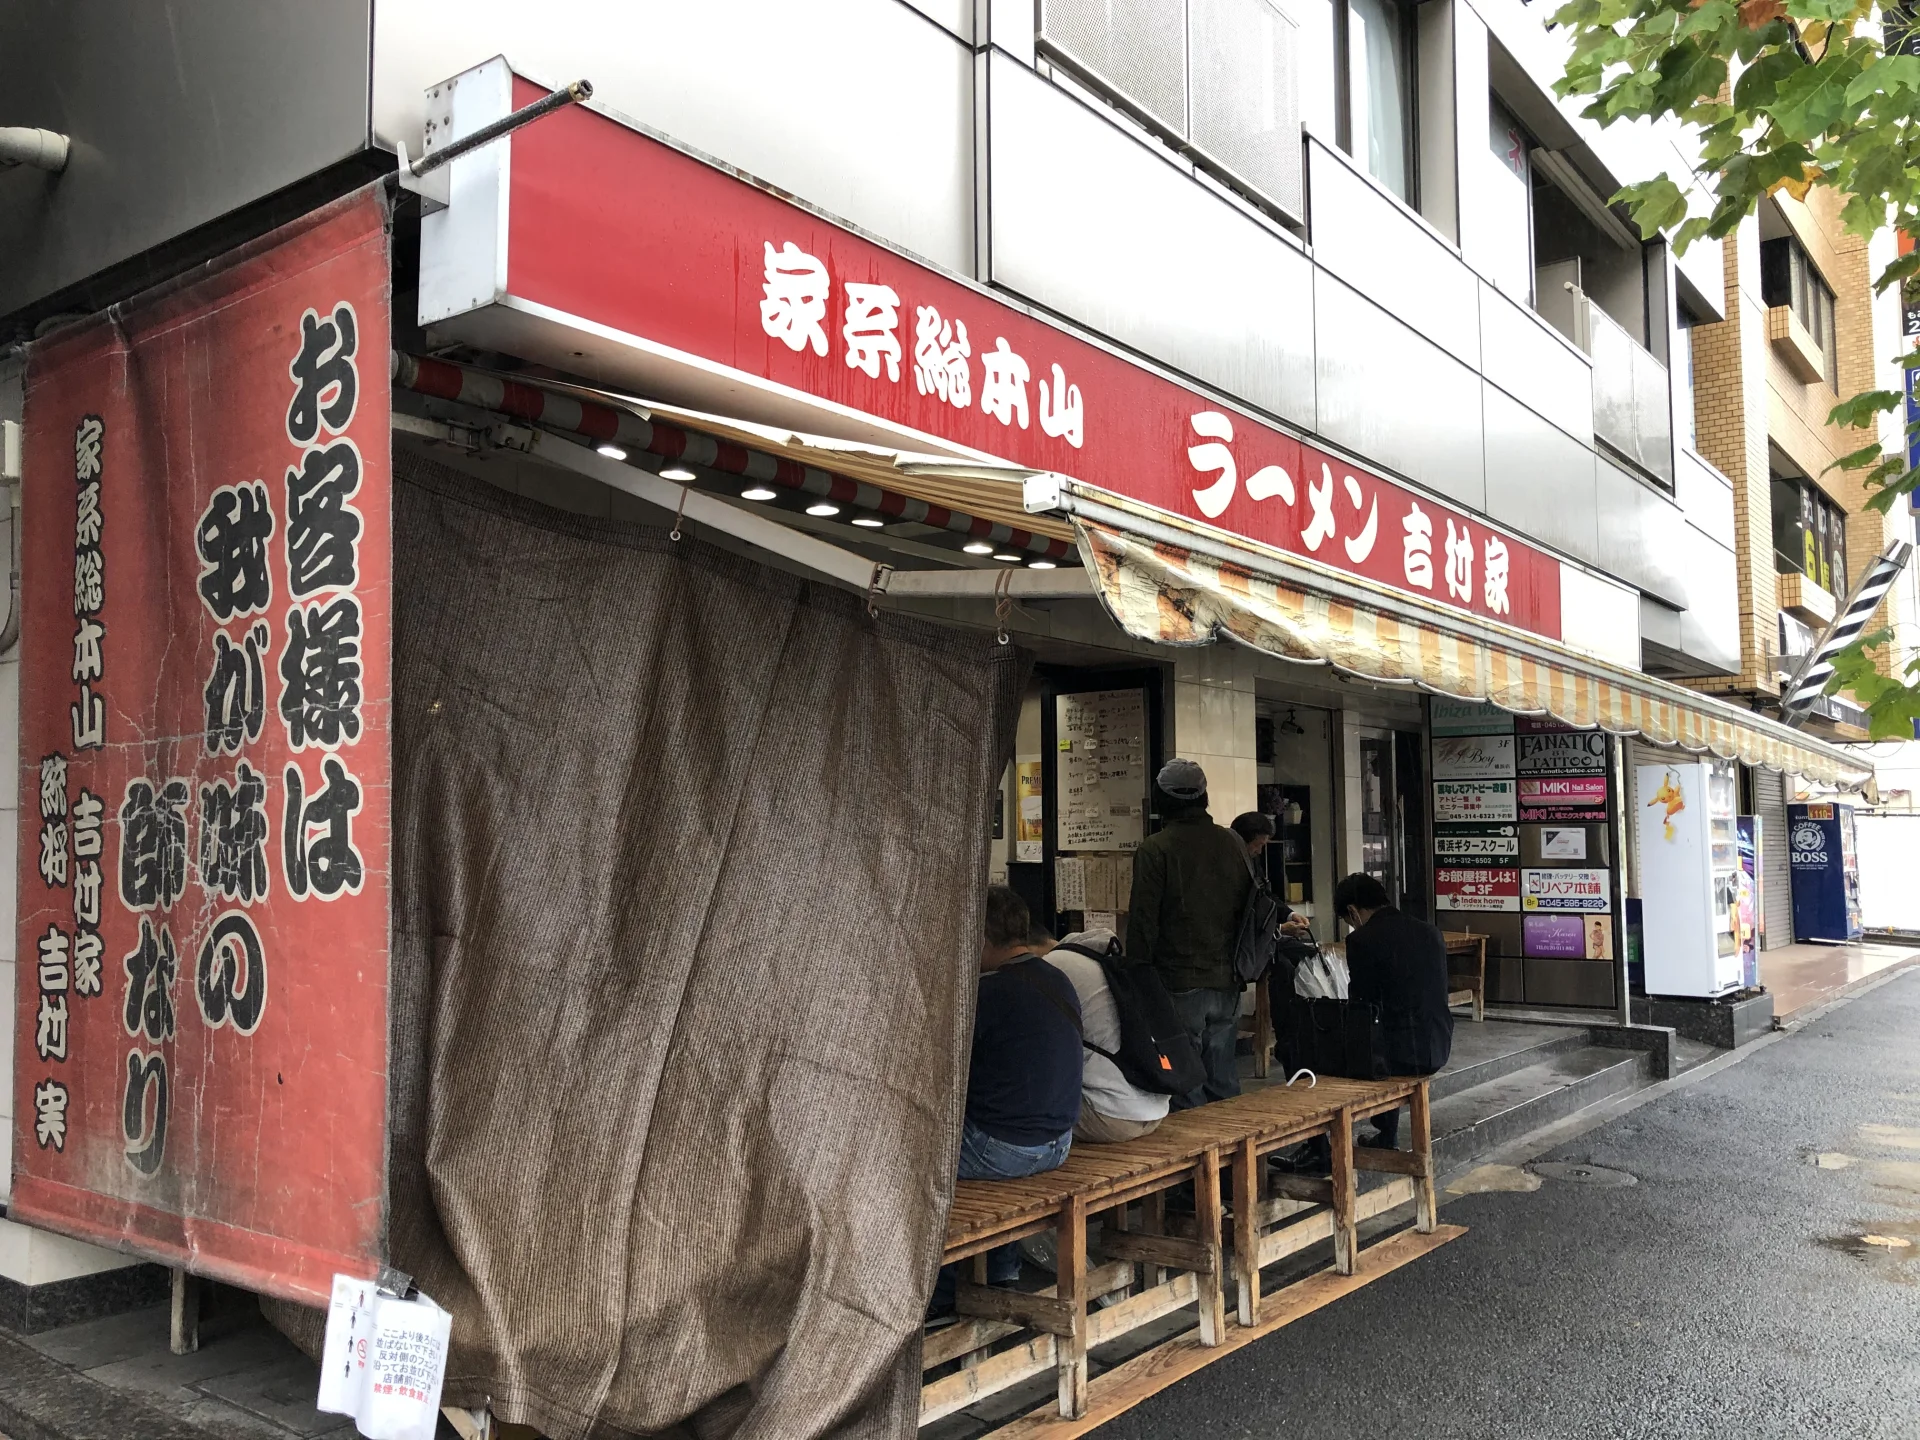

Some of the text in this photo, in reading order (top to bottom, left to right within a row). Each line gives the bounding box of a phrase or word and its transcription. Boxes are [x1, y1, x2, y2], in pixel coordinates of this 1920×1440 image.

[759, 240, 1510, 616] 家系総本山 ラーメン 吉村家
[280, 300, 364, 903] お客様は
[71, 415, 105, 998] 家系総本山 吉村家
[1497, 739, 1511, 749] 3F
[1519, 733, 1604, 762] FANATIC
[195, 480, 275, 1037] 我が味の
[1530, 756, 1592, 768] TATTOO
[1542, 782, 1570, 793] MIKI
[1519, 808, 1547, 820] MIKI
[1793, 821, 1821, 832] COFFEE
[1437, 838, 1515, 853] 横浜ギタースクール
[1791, 851, 1828, 863] BOSS
[1437, 870, 1516, 884] お部屋探しは!
[1477, 884, 1493, 895] 3F
[1541, 882, 1601, 895] リペア本舗
[1483, 897, 1505, 905] home
[117, 777, 190, 1180] 師なり
[37, 928, 69, 1063] 吉村
[34, 1082, 69, 1153] 実
[382, 1372, 432, 1394] 店舗前につき
